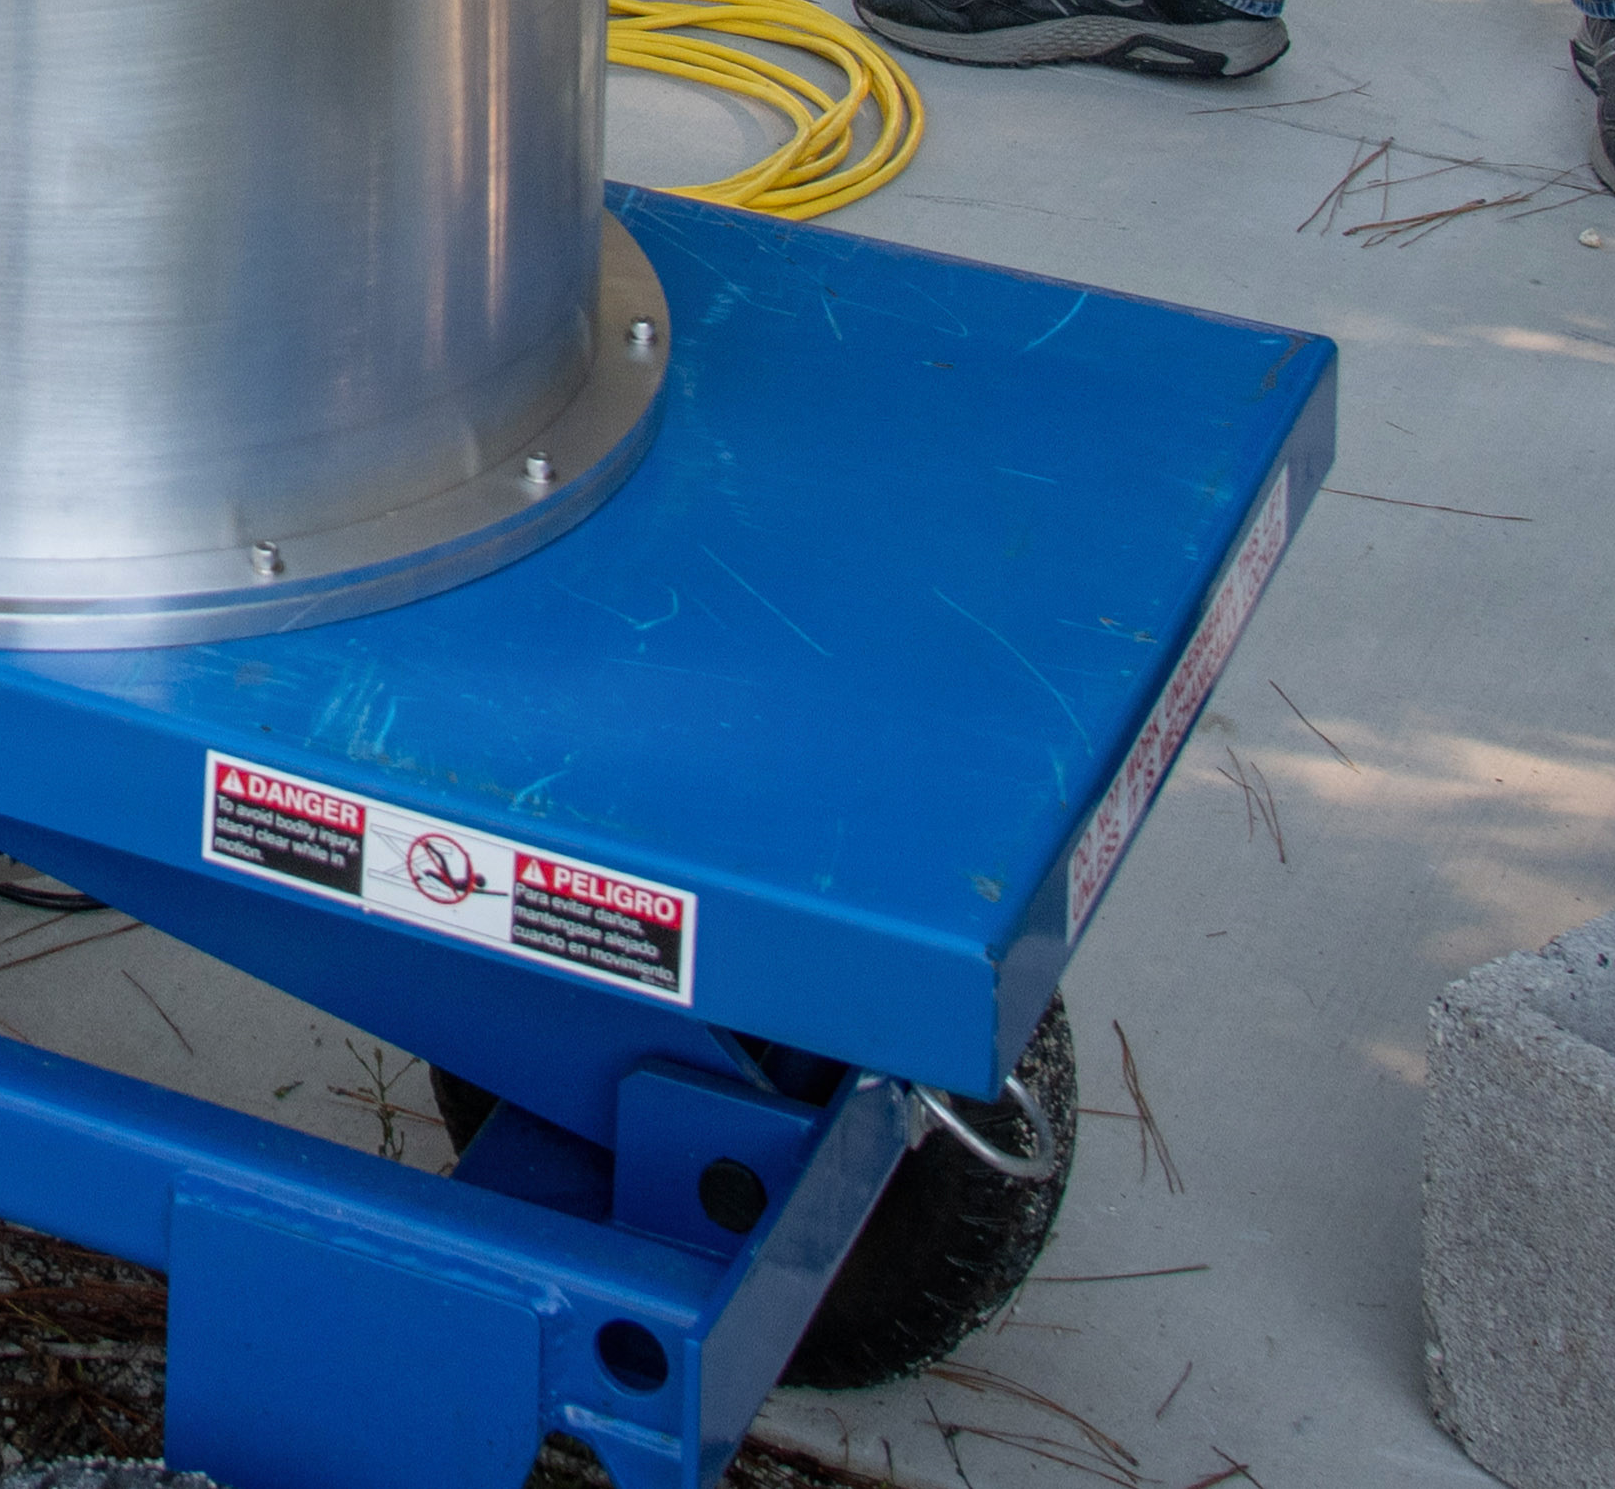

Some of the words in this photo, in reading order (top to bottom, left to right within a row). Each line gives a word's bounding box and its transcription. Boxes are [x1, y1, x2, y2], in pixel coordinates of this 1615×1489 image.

[217, 794, 235, 813] To
[235, 802, 274, 826] avoid
[275, 812, 317, 841] bodily
[318, 826, 360, 854] injury,
[247, 774, 359, 829] DANGER
[213, 836, 265, 862] motion.
[215, 816, 254, 840] stand
[255, 828, 290, 850] clear
[291, 839, 330, 862] while
[330, 851, 346, 868] in
[514, 881, 550, 906] Para
[551, 896, 593, 920] evitar
[553, 865, 677, 923] PELIGRO
[512, 924, 566, 951] cuando
[568, 939, 588, 958] en
[590, 947, 677, 984] movimiento.
[513, 904, 603, 942] mantengase
[604, 930, 660, 960] alejado
